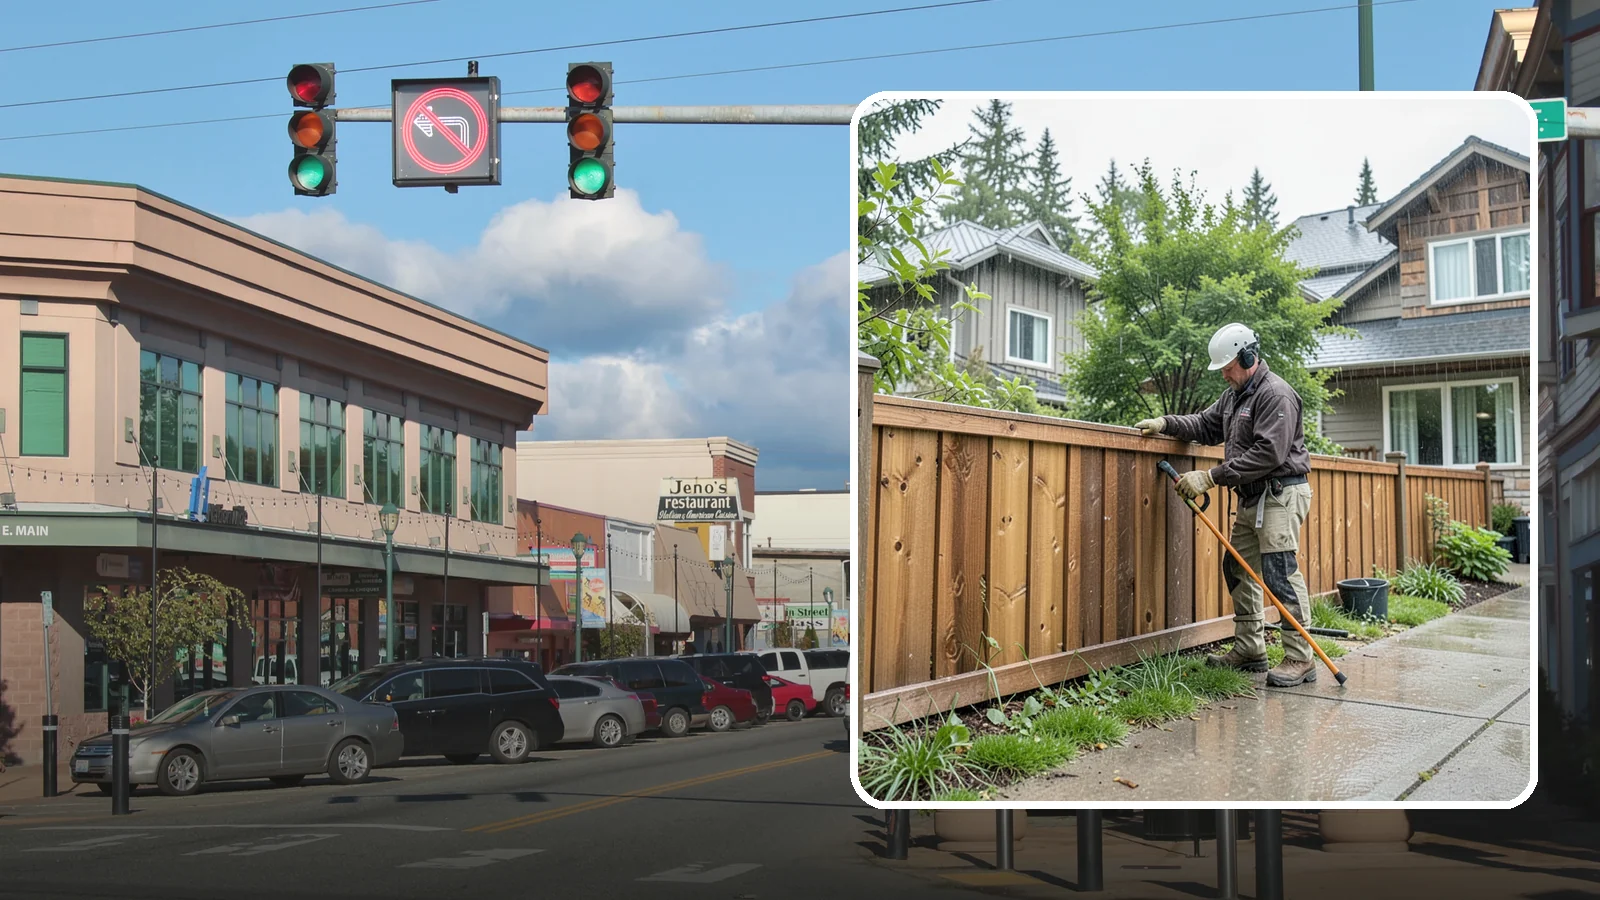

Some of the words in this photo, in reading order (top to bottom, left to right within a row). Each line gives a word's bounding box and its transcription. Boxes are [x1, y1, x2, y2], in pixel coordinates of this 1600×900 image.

[669, 480, 727, 494] Jeno's
[665, 496, 731, 509] restaurant
[686, 510, 714, 519] American
[715, 509, 737, 519] Cuisine
[2, 525, 13, 536] E.
[15, 525, 49, 536] MAIN
[797, 607, 828, 616] Street
